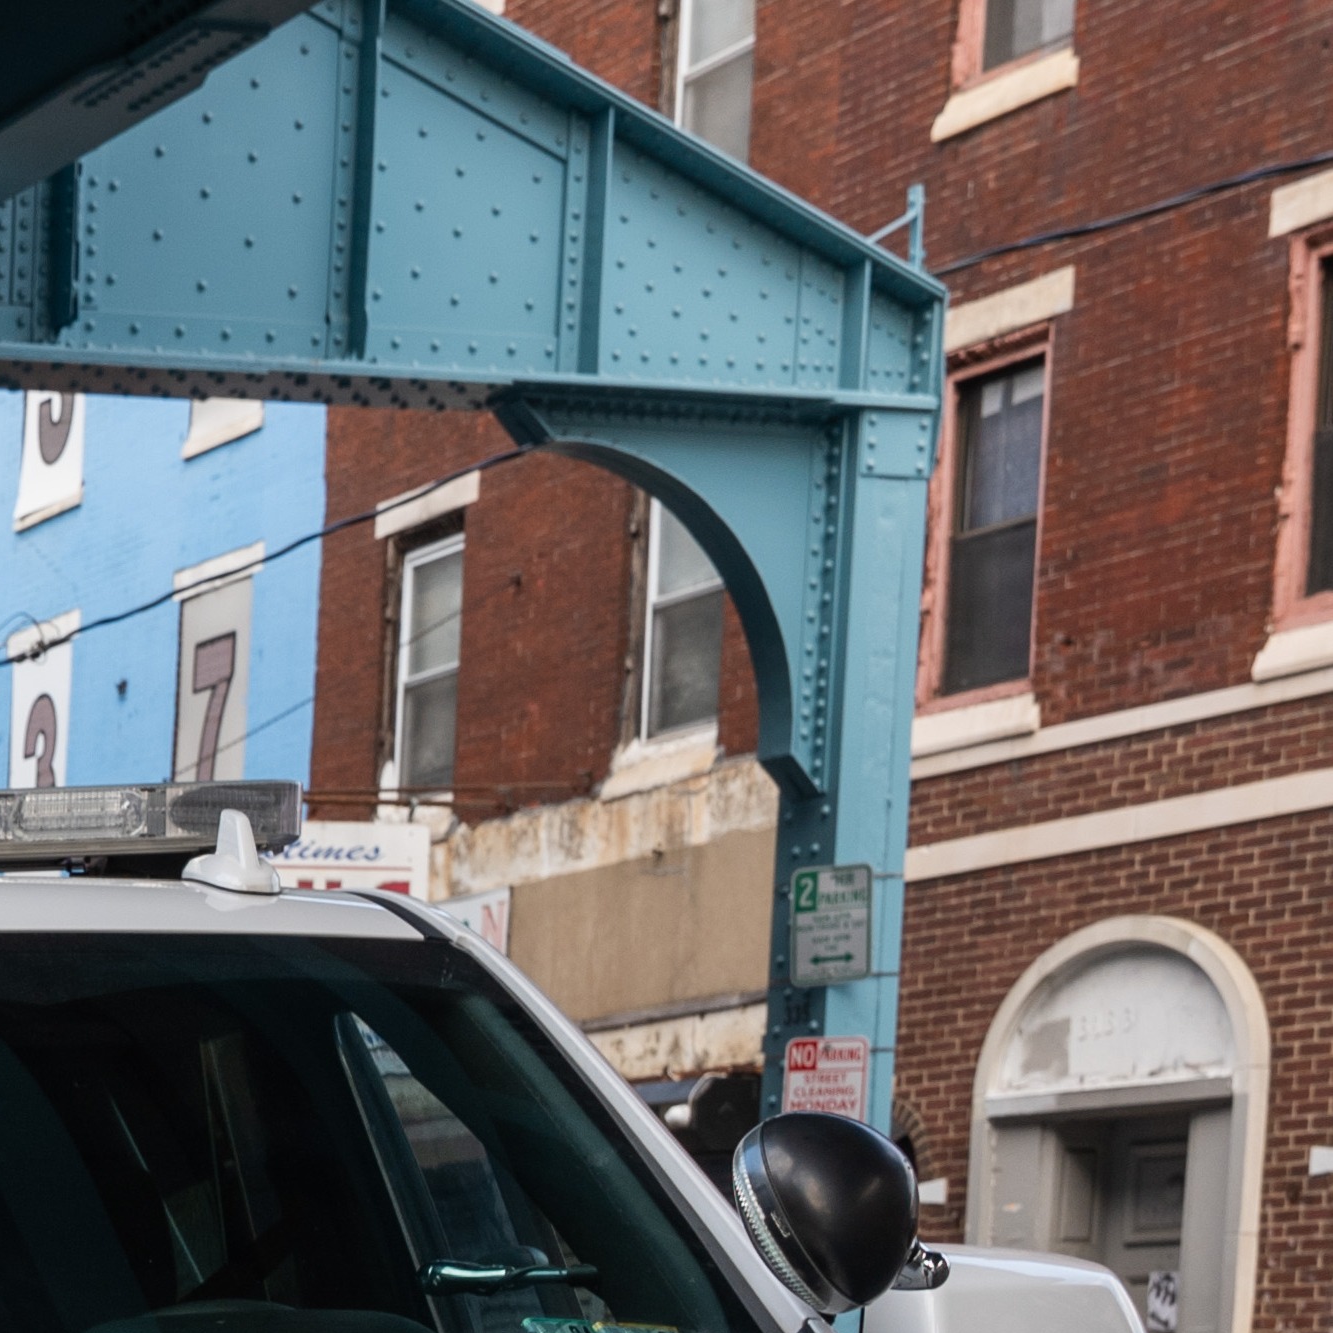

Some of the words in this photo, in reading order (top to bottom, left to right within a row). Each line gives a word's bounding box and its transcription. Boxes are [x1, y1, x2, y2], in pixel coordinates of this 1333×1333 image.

[193, 631, 237, 782] 7
[265, 841, 381, 861] times
[799, 878, 814, 906] 2
[791, 1044, 815, 1068] NO
[804, 1073, 846, 1083] STREET
[794, 1086, 854, 1097] CLEANING
[790, 1099, 857, 1113] MONDAY
